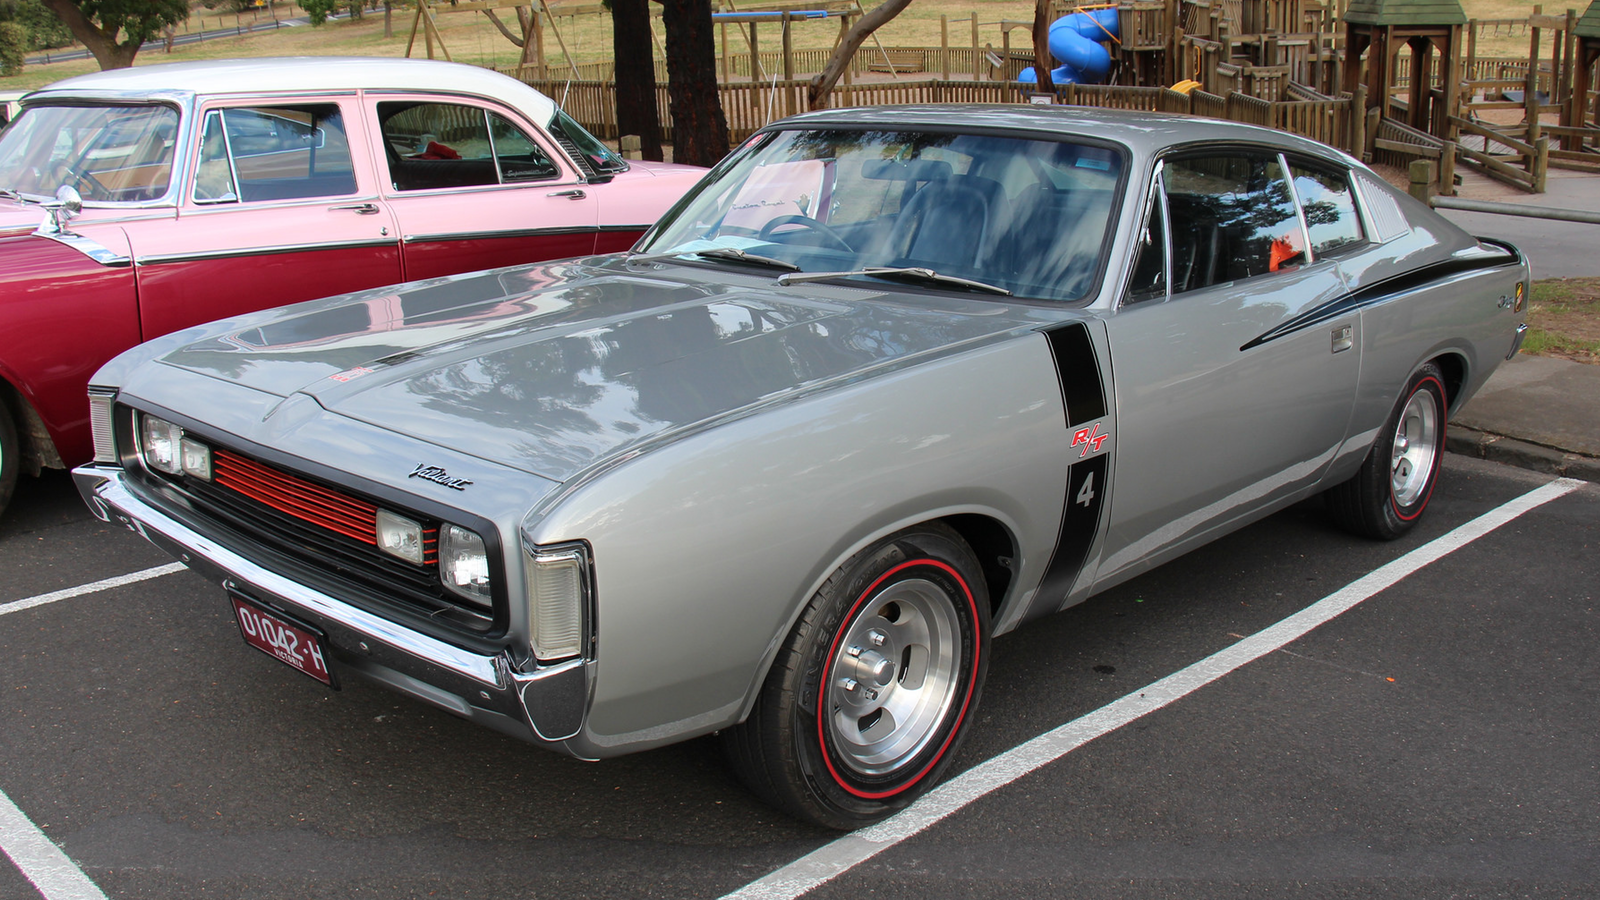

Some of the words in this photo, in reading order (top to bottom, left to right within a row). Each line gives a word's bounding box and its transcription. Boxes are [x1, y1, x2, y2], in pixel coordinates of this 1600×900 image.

[1070, 422, 1109, 458] R/T
[408, 462, 474, 491] Valiant
[1076, 471, 1095, 508] 4
[273, 647, 304, 669] VICTORIA
